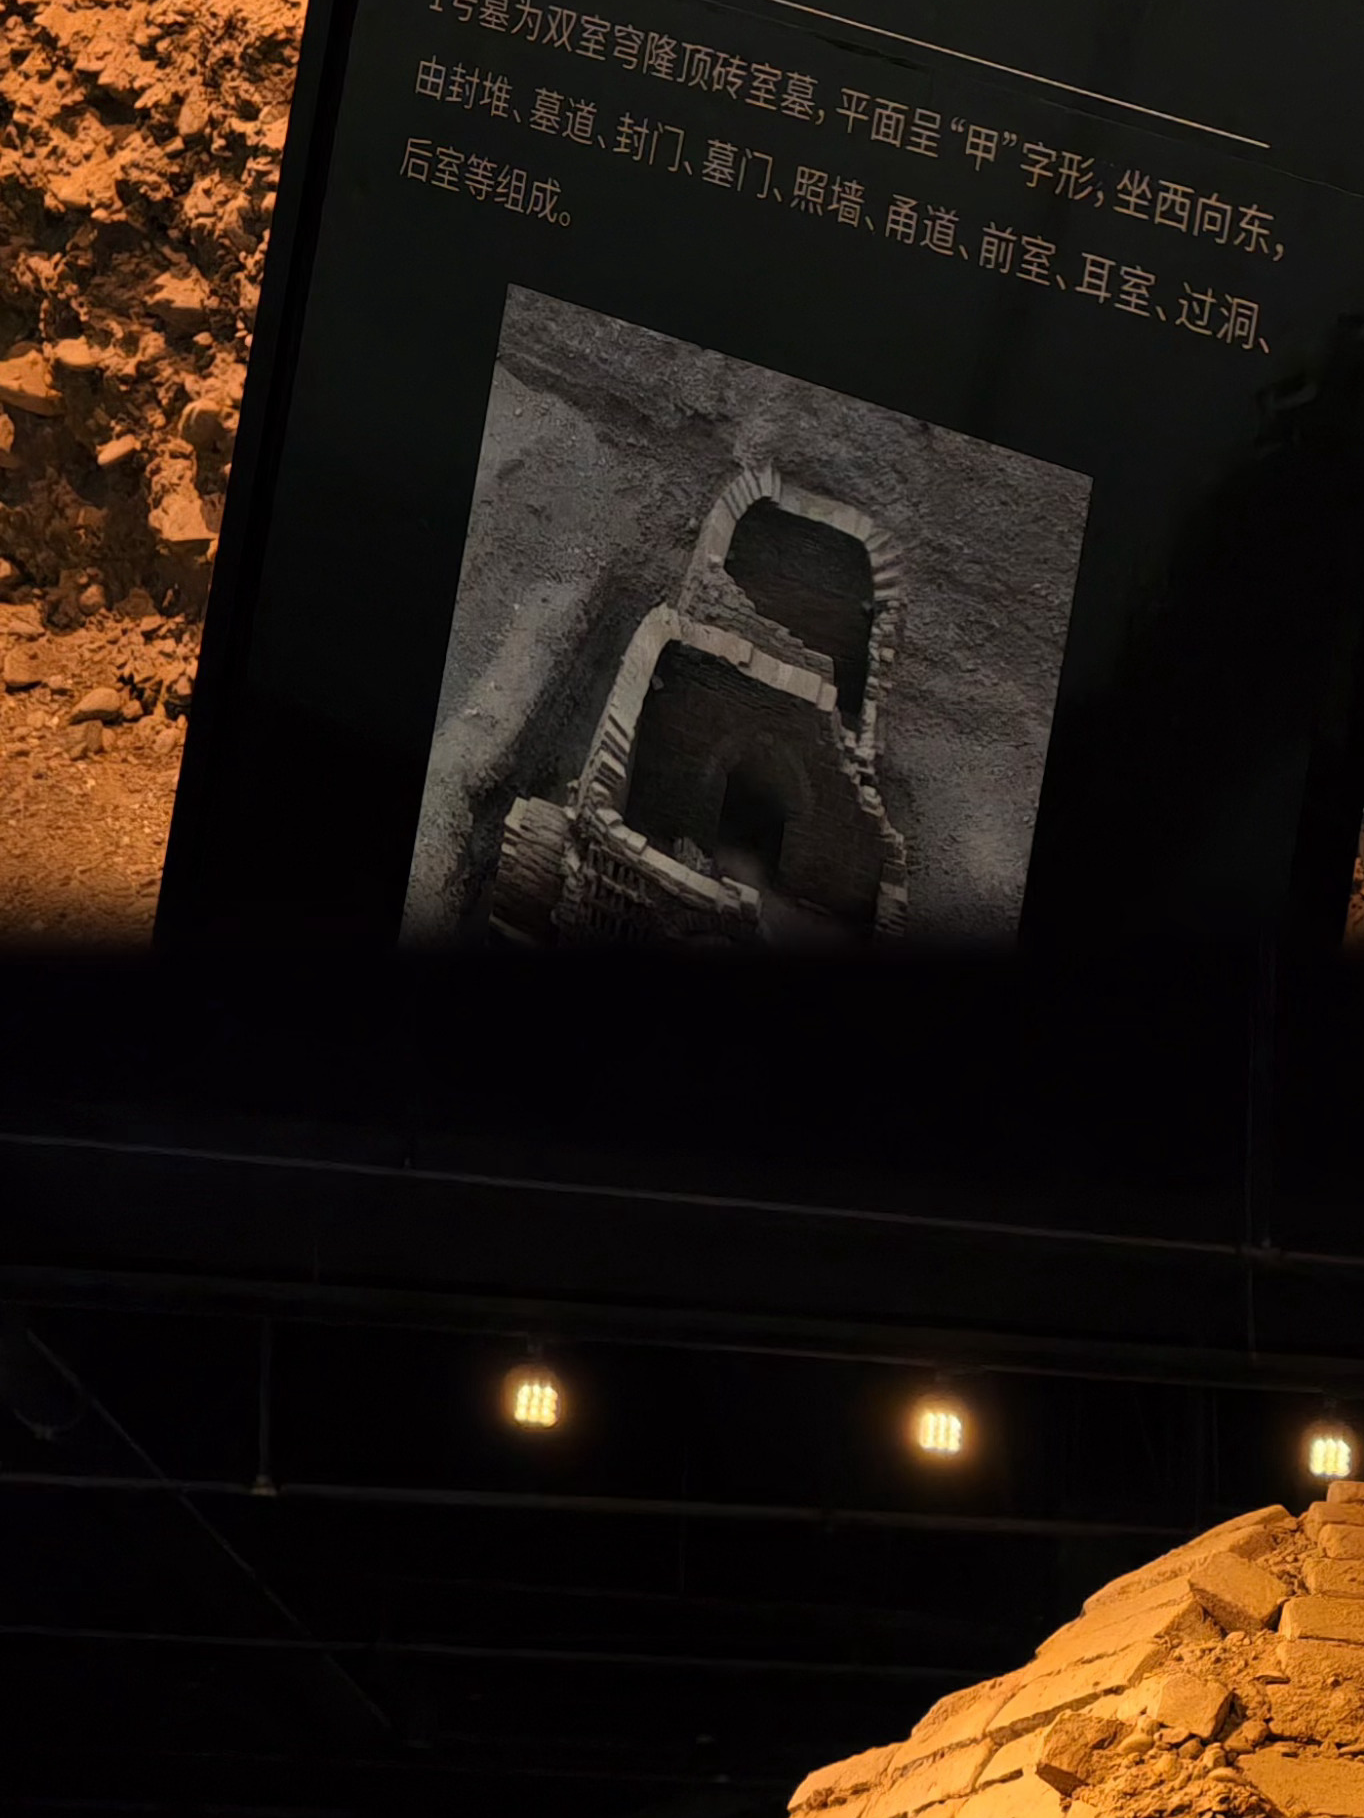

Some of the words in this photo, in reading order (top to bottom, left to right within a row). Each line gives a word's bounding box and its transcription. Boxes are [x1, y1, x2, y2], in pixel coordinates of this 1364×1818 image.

[399, 136, 571, 227] 后室等组成。
